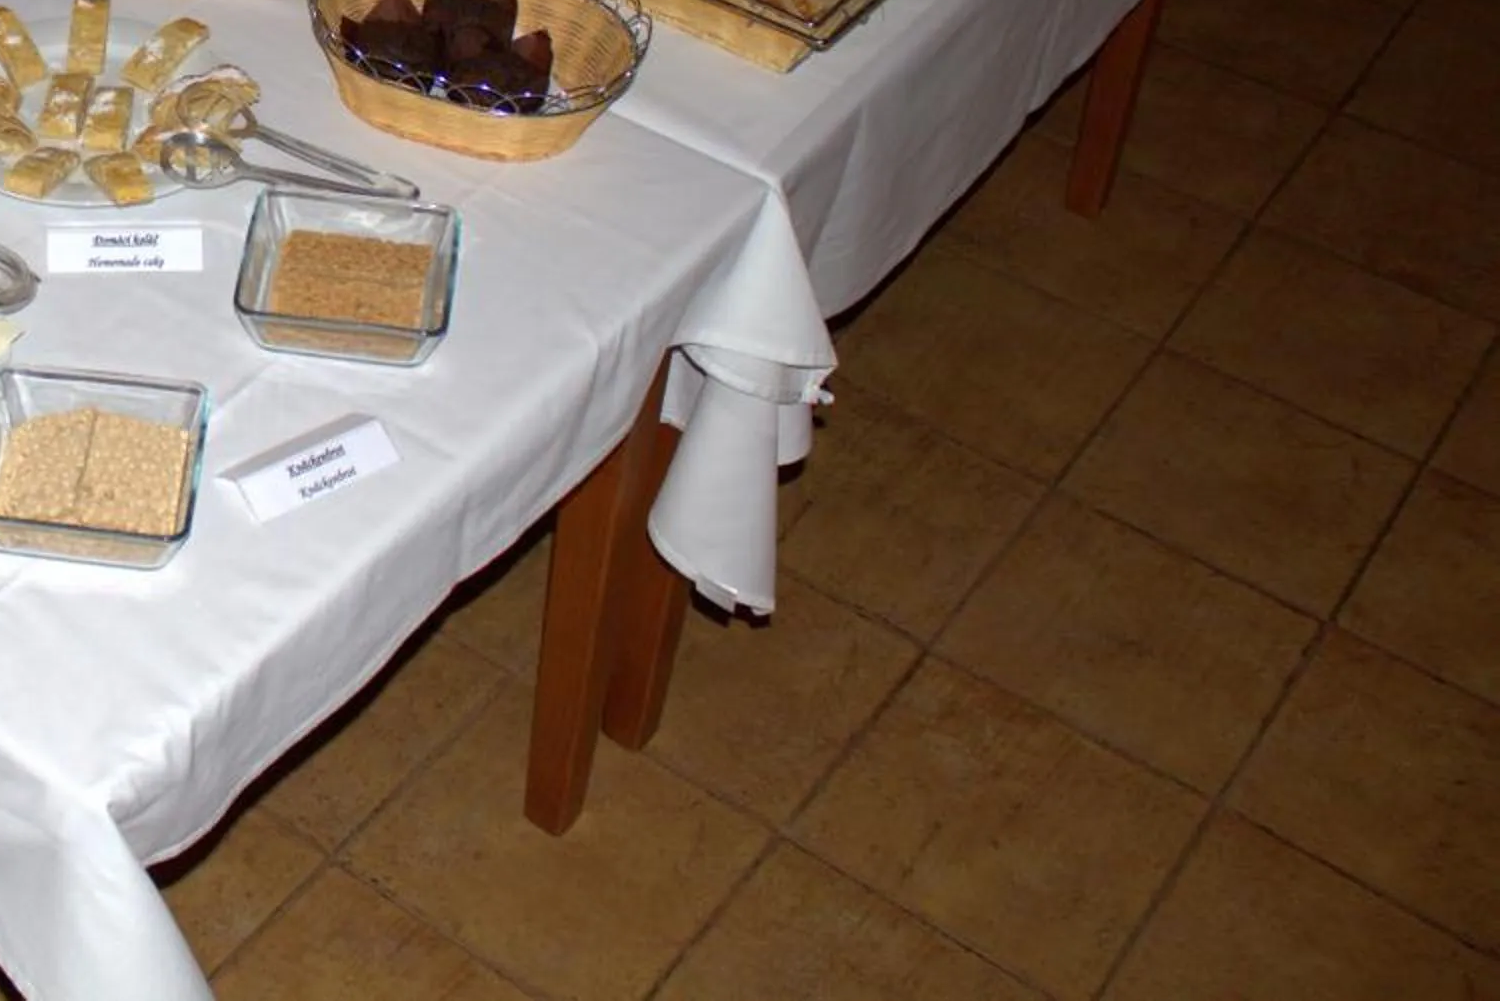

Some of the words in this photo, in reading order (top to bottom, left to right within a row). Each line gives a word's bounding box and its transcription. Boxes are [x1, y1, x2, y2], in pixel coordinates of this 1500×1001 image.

[92, 234, 131, 246] Domácí
[133, 233, 159, 246] koláč
[87, 255, 140, 267] Homemade
